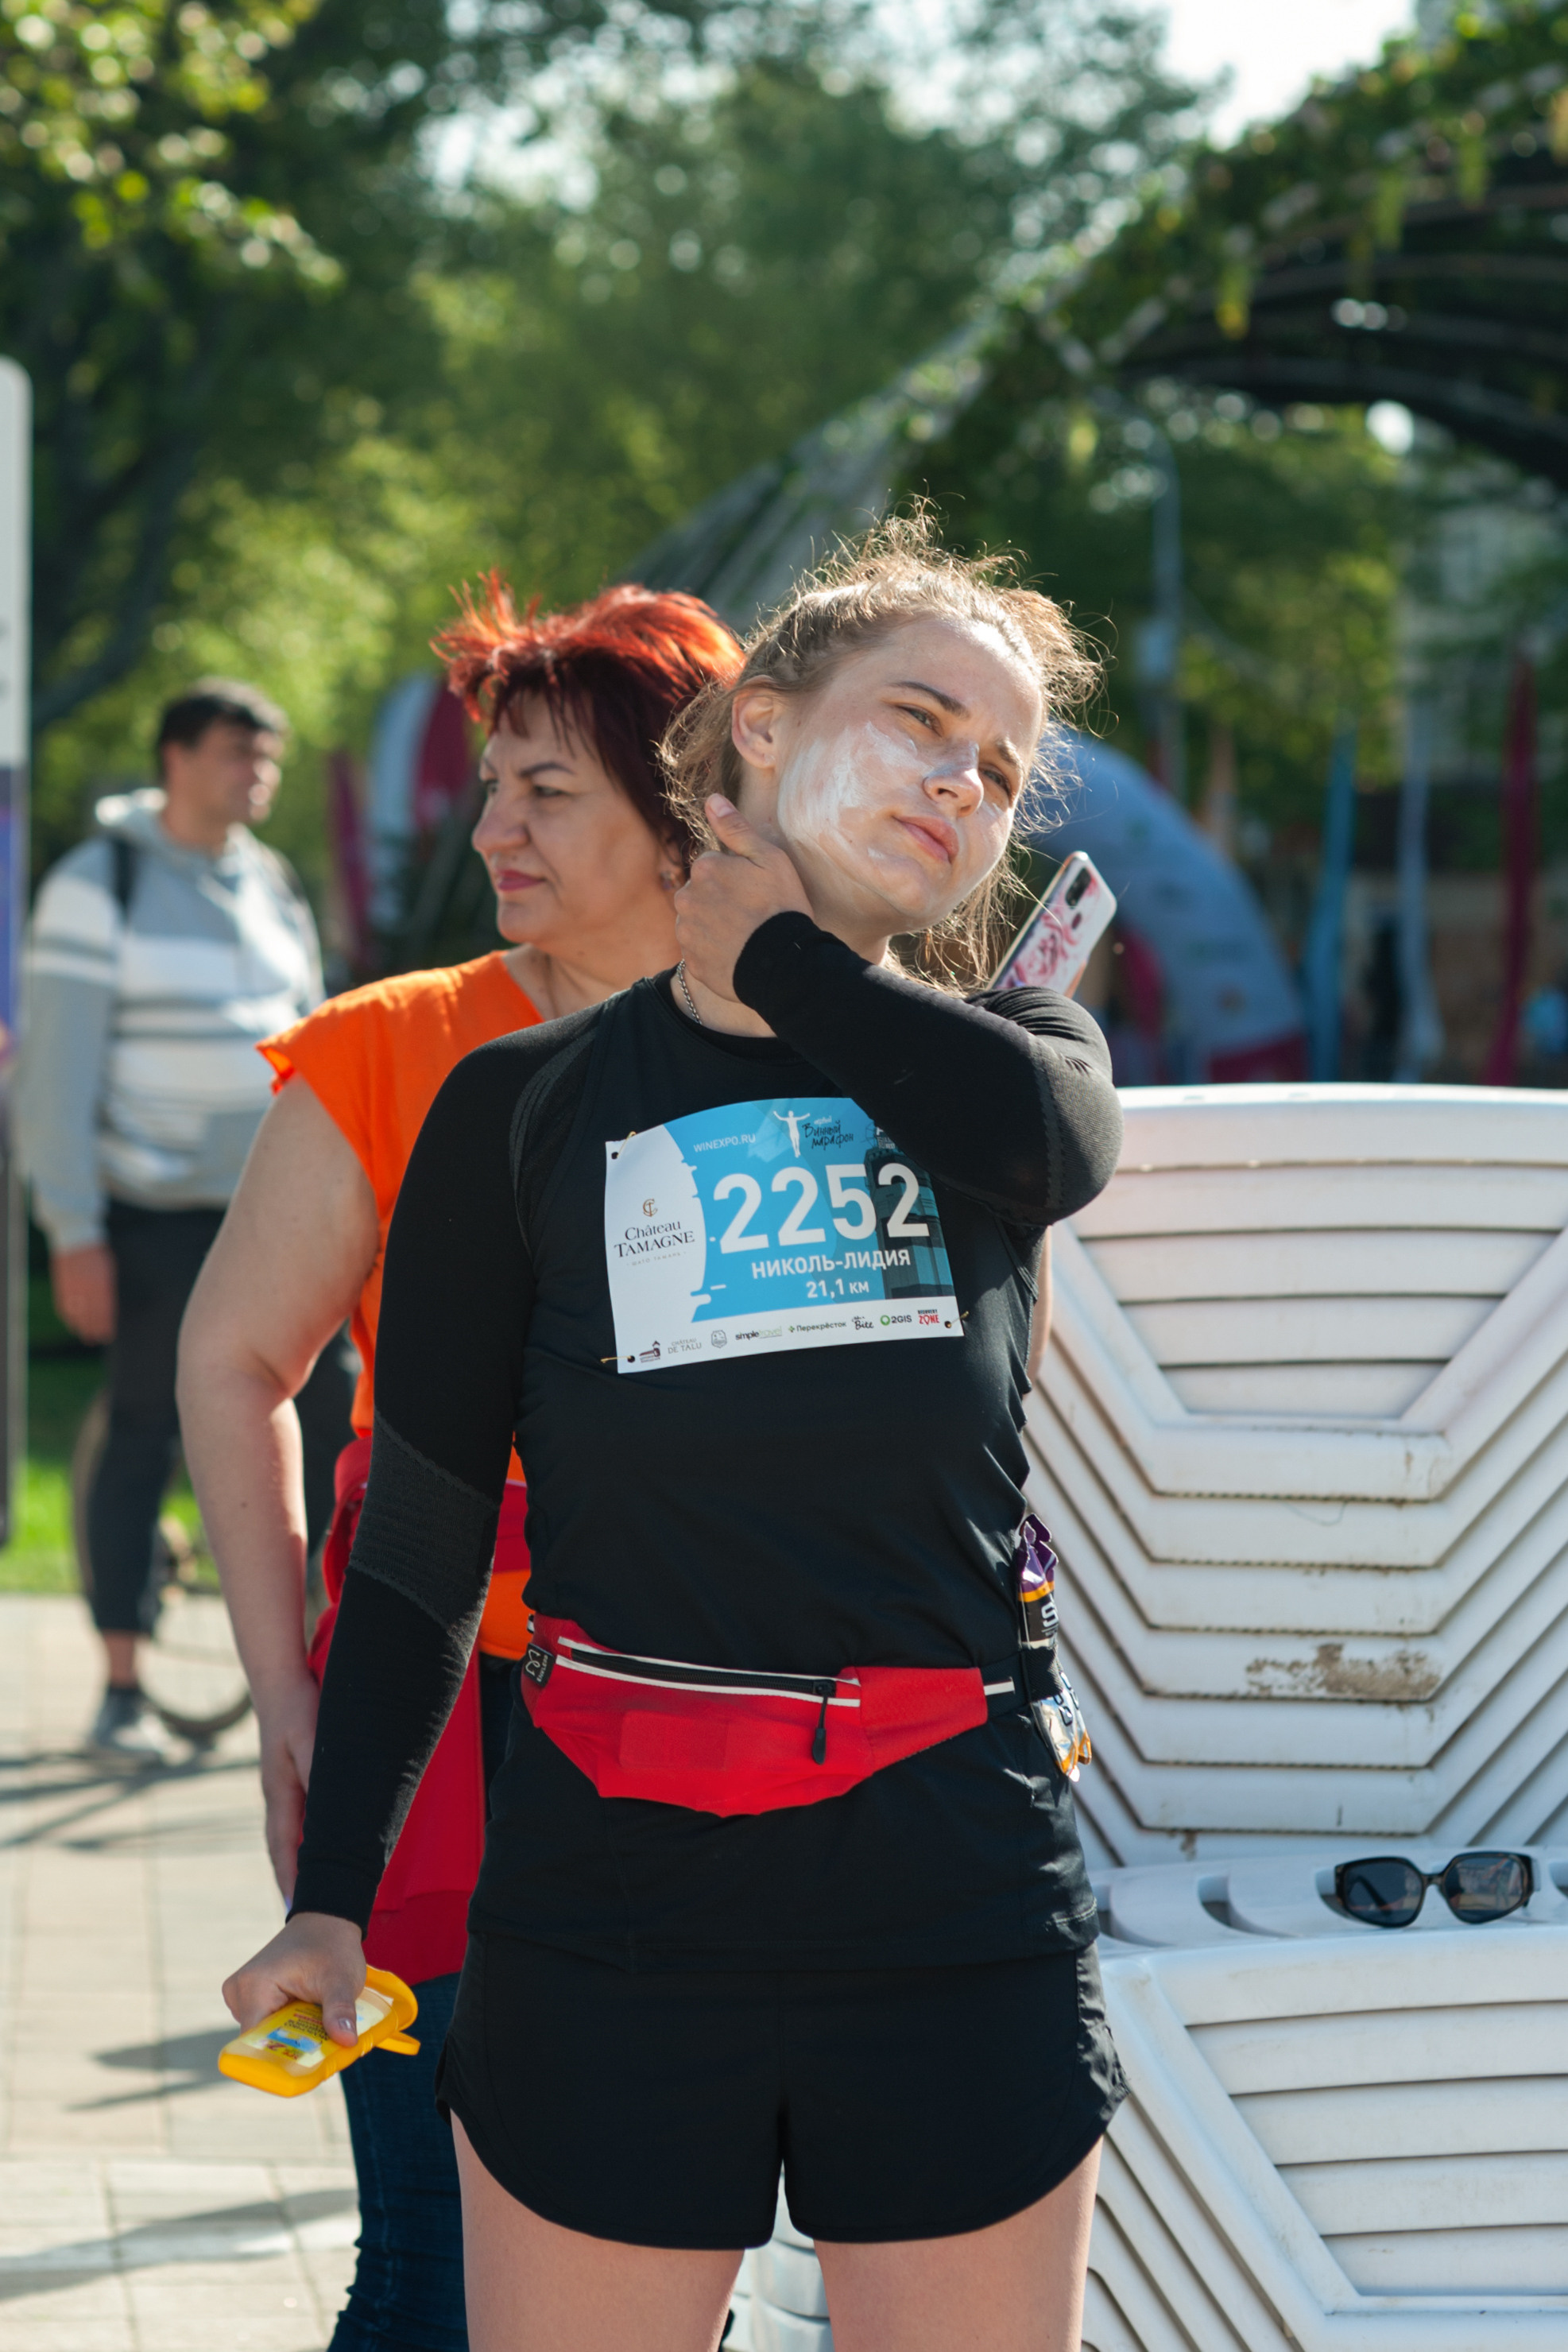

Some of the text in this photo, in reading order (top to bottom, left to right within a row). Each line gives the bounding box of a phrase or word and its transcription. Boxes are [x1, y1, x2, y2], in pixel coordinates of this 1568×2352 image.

[693, 1133, 756, 1153] WINEXPO.RU
[714, 1162, 930, 1254] 2252
[625, 1221, 681, 1241] Château
[614, 1230, 695, 1258] TAMAGNE
[751, 1249, 911, 1279] НИКОЛЬ-ЛИДИЯ
[805, 1278, 845, 1299] 21,1
[796, 1320, 847, 1332] Перекрёсток
[891, 1315, 912, 1324] 2GIS
[680, 1342, 703, 1353] TALU
